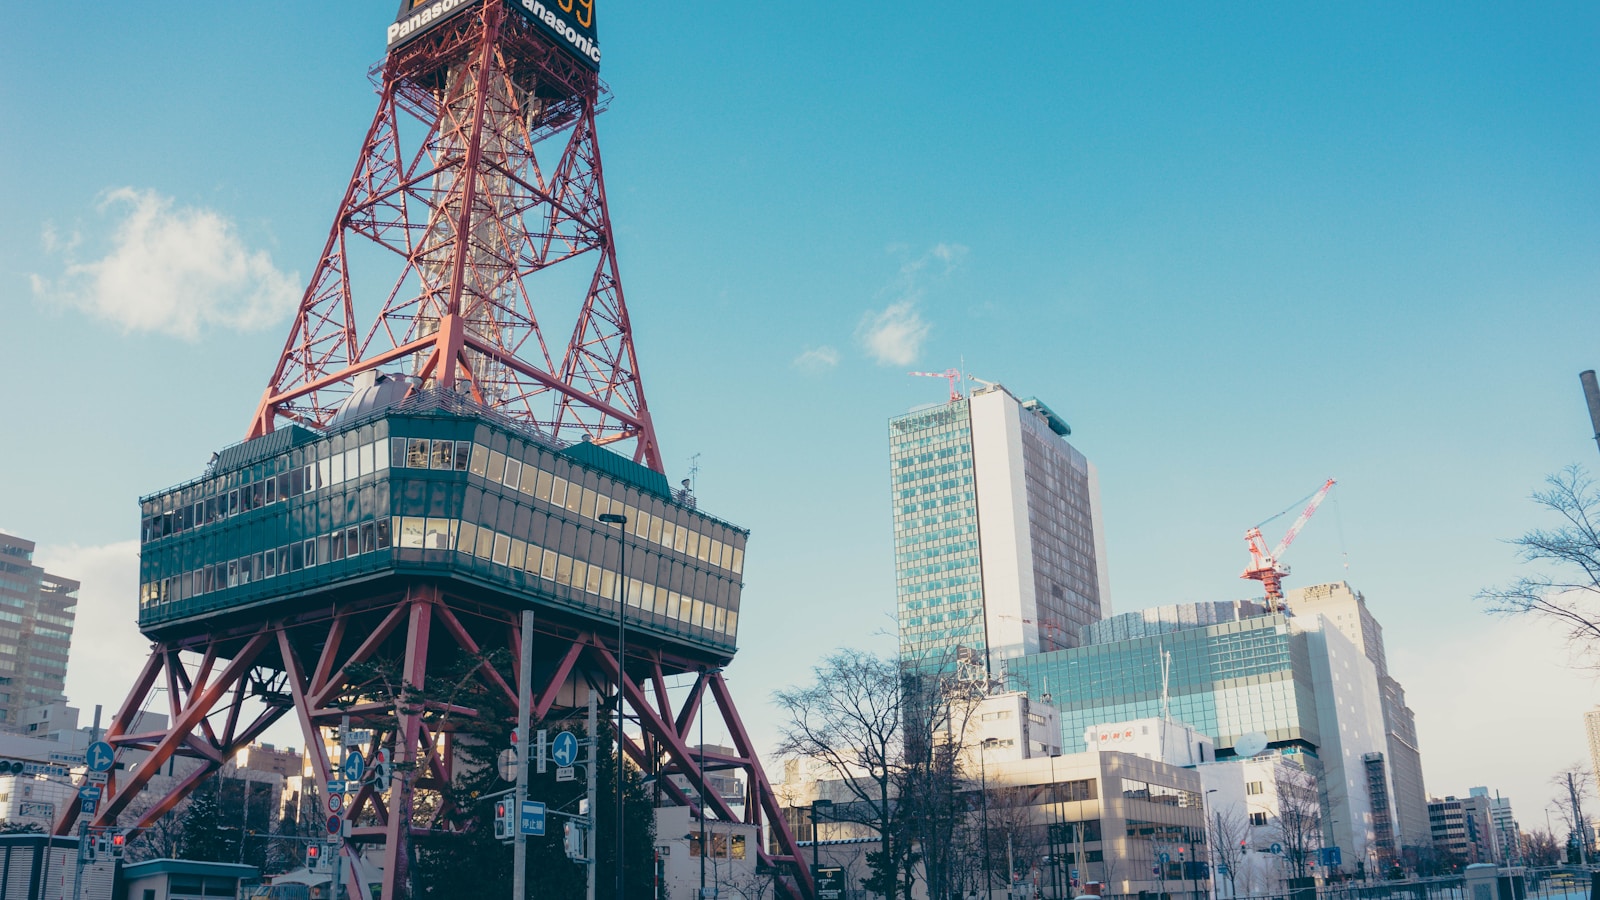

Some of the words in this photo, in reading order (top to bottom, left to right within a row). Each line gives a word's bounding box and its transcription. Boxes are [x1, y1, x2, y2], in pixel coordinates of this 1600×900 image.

[1100, 730, 1133, 742] NHK
[331, 798, 339, 808] 50
[522, 818, 543, 830] 停止線
